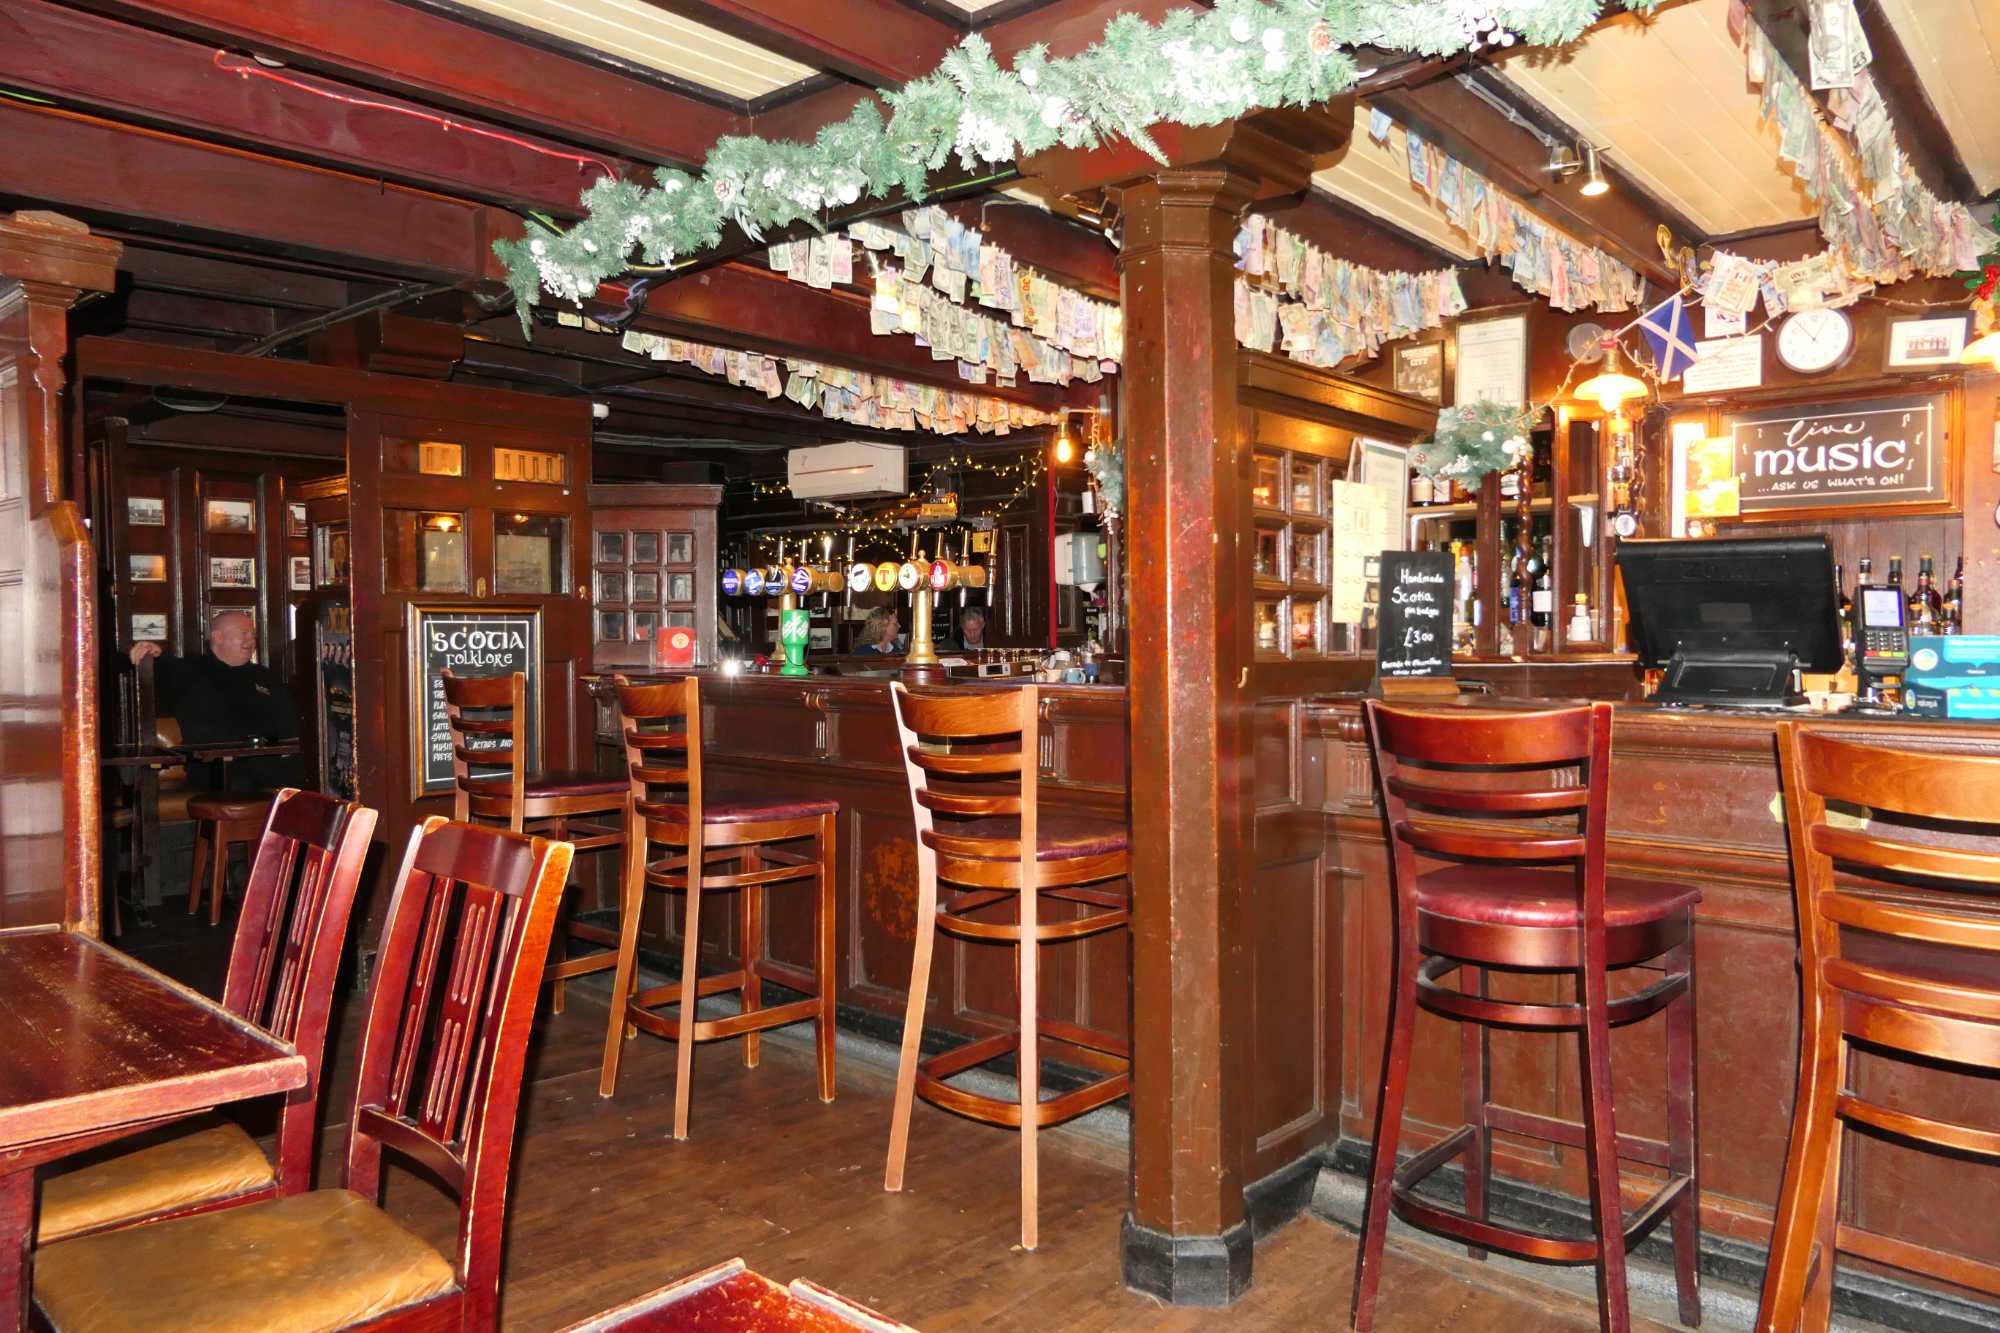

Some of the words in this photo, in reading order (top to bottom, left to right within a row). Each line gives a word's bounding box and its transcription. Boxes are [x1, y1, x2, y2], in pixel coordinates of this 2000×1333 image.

[1783, 419, 1866, 448] live
[1753, 436, 1906, 477] music
[1802, 479, 1819, 490] US
[1827, 476, 1876, 488] WHAT'S
[1879, 473, 1905, 486] ON!
[1400, 568, 1445, 585] Handmade
[1391, 585, 1435, 604] Scotia
[434, 631, 525, 652] SCOTIA
